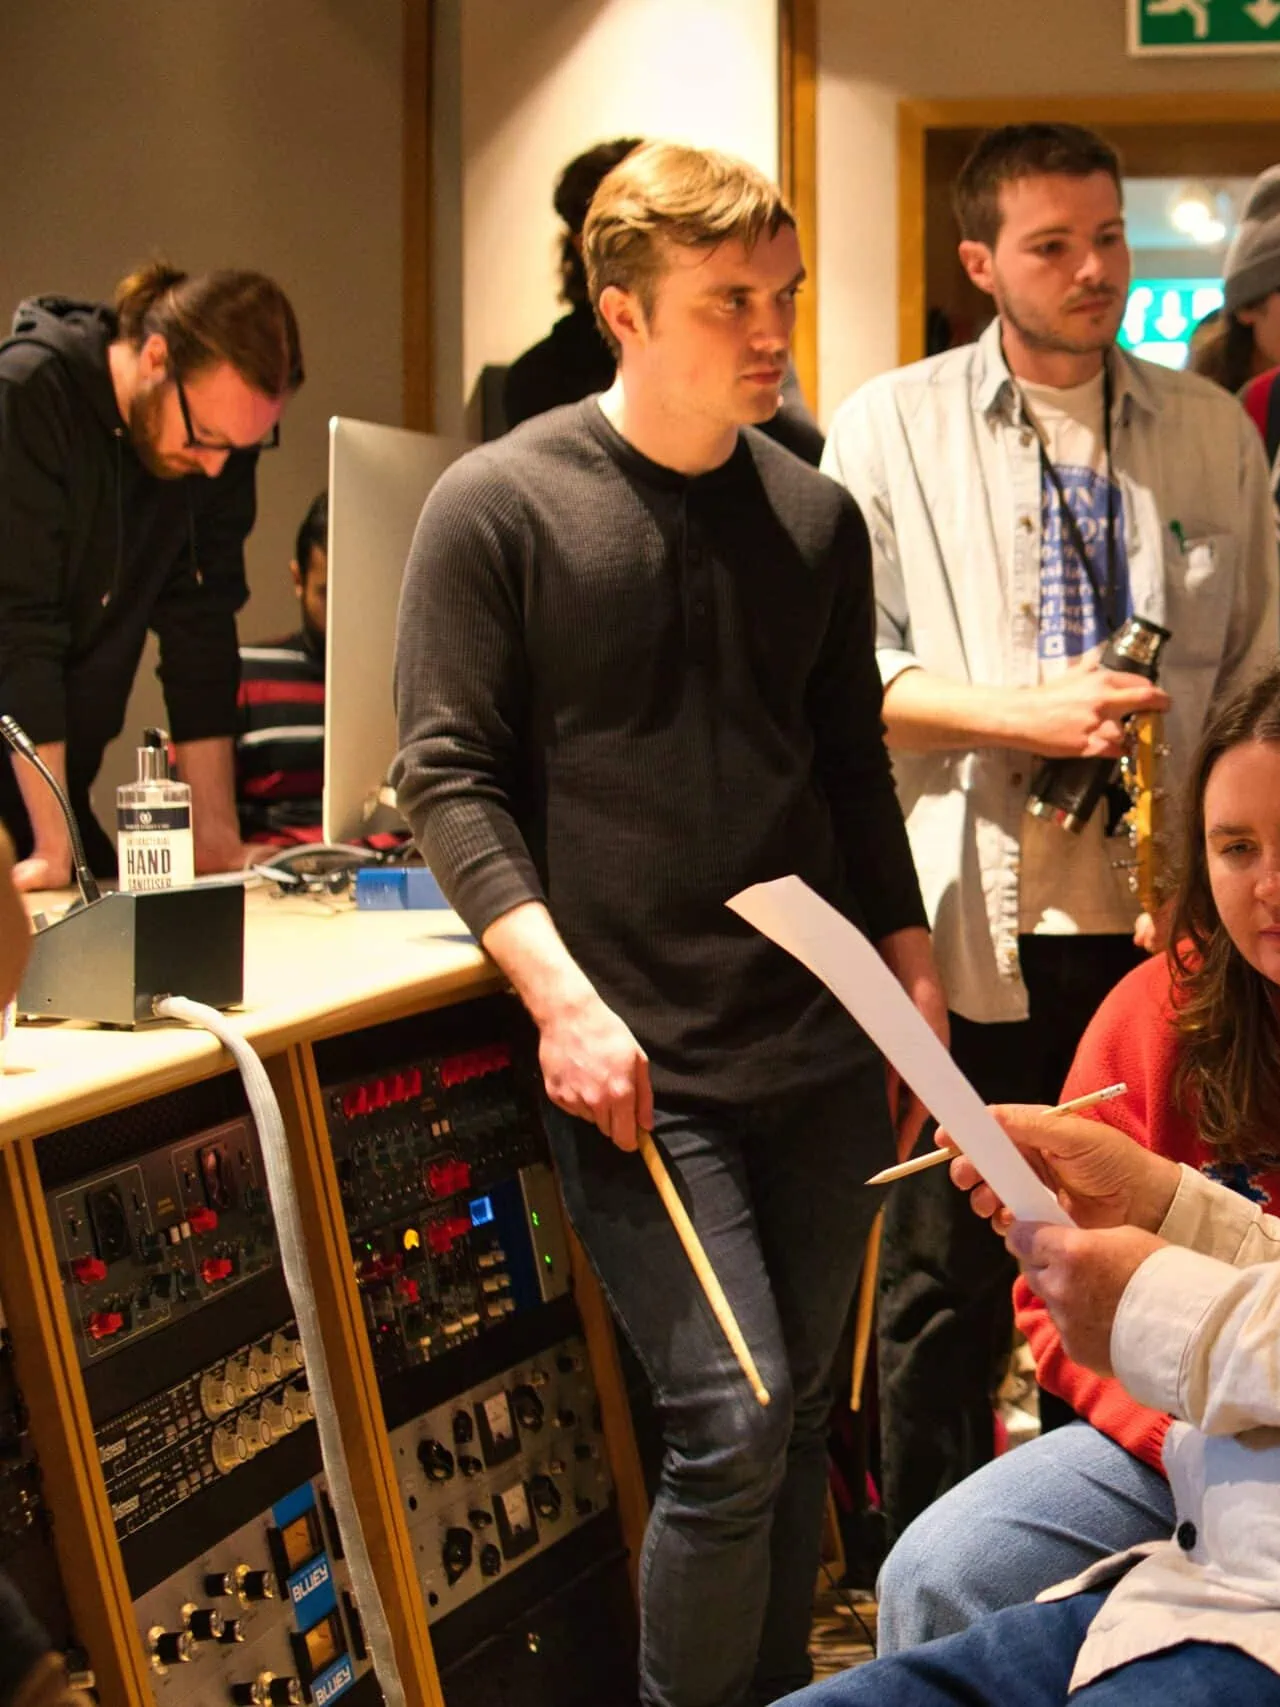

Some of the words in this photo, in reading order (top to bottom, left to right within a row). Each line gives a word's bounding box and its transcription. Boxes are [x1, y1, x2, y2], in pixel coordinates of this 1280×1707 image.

[127, 848, 171, 875] HAND
[291, 1563, 329, 1603] BLUEY
[315, 1664, 352, 1706] BLUEY
